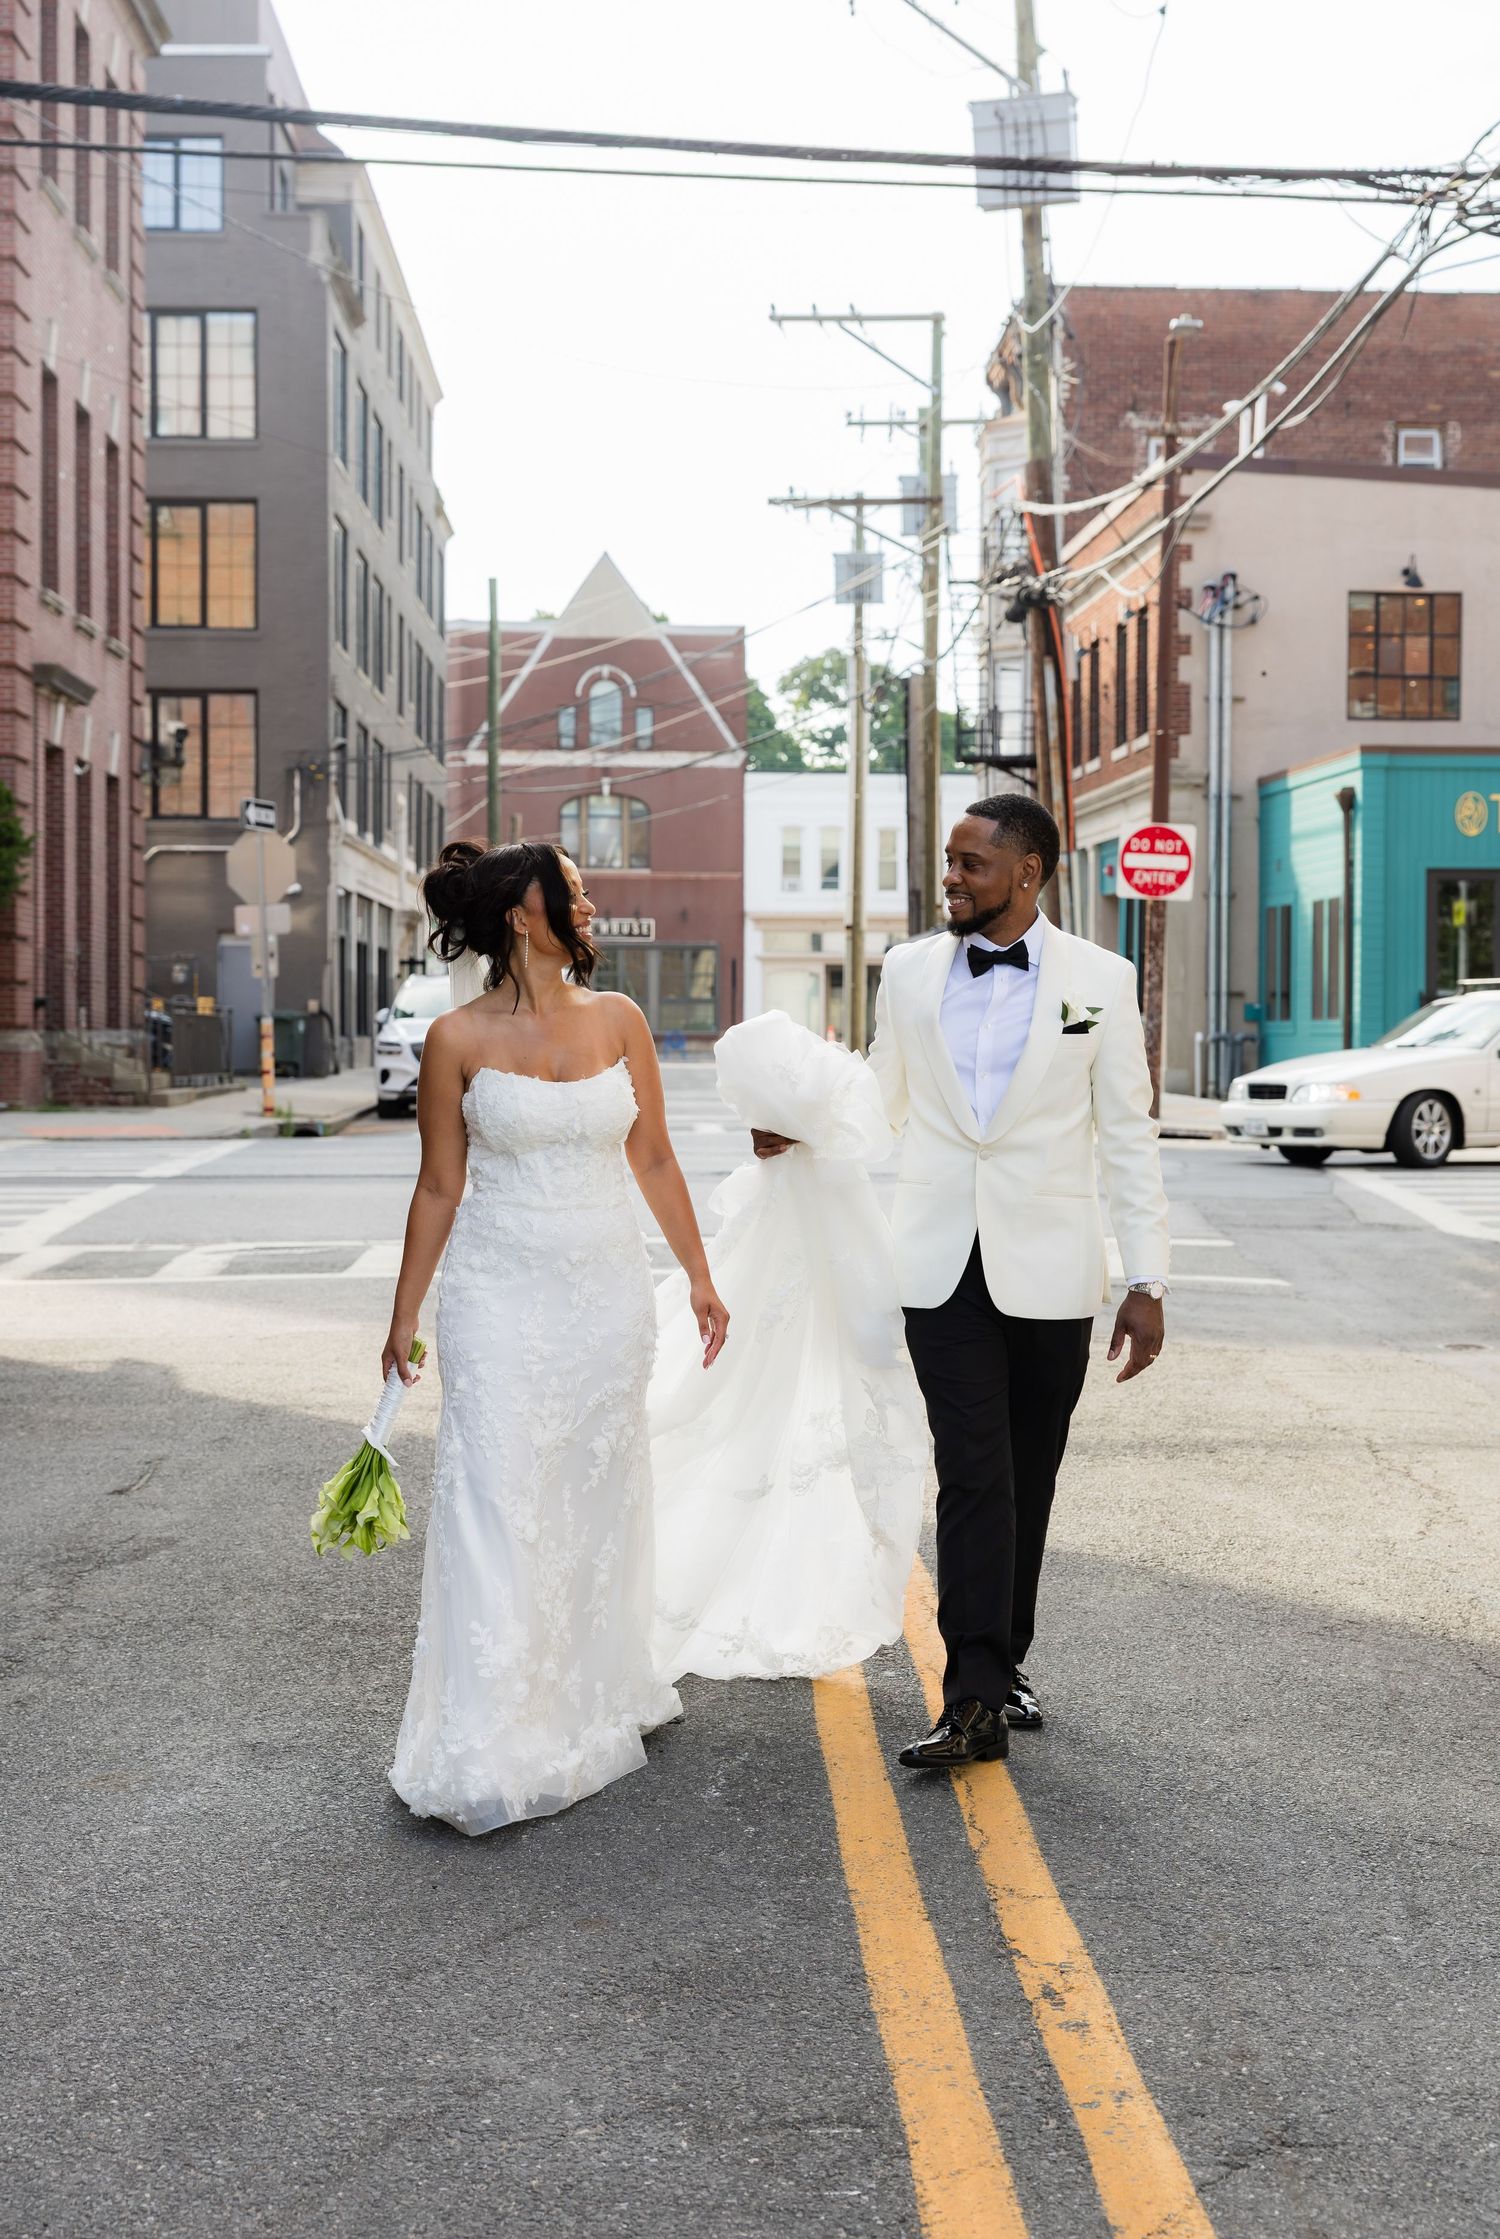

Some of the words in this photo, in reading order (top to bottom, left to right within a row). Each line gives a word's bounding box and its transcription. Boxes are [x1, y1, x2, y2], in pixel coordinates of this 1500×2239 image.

[1130, 837, 1151, 852] DO
[1154, 839, 1183, 853] NOT
[1133, 871, 1176, 885] ENTER
